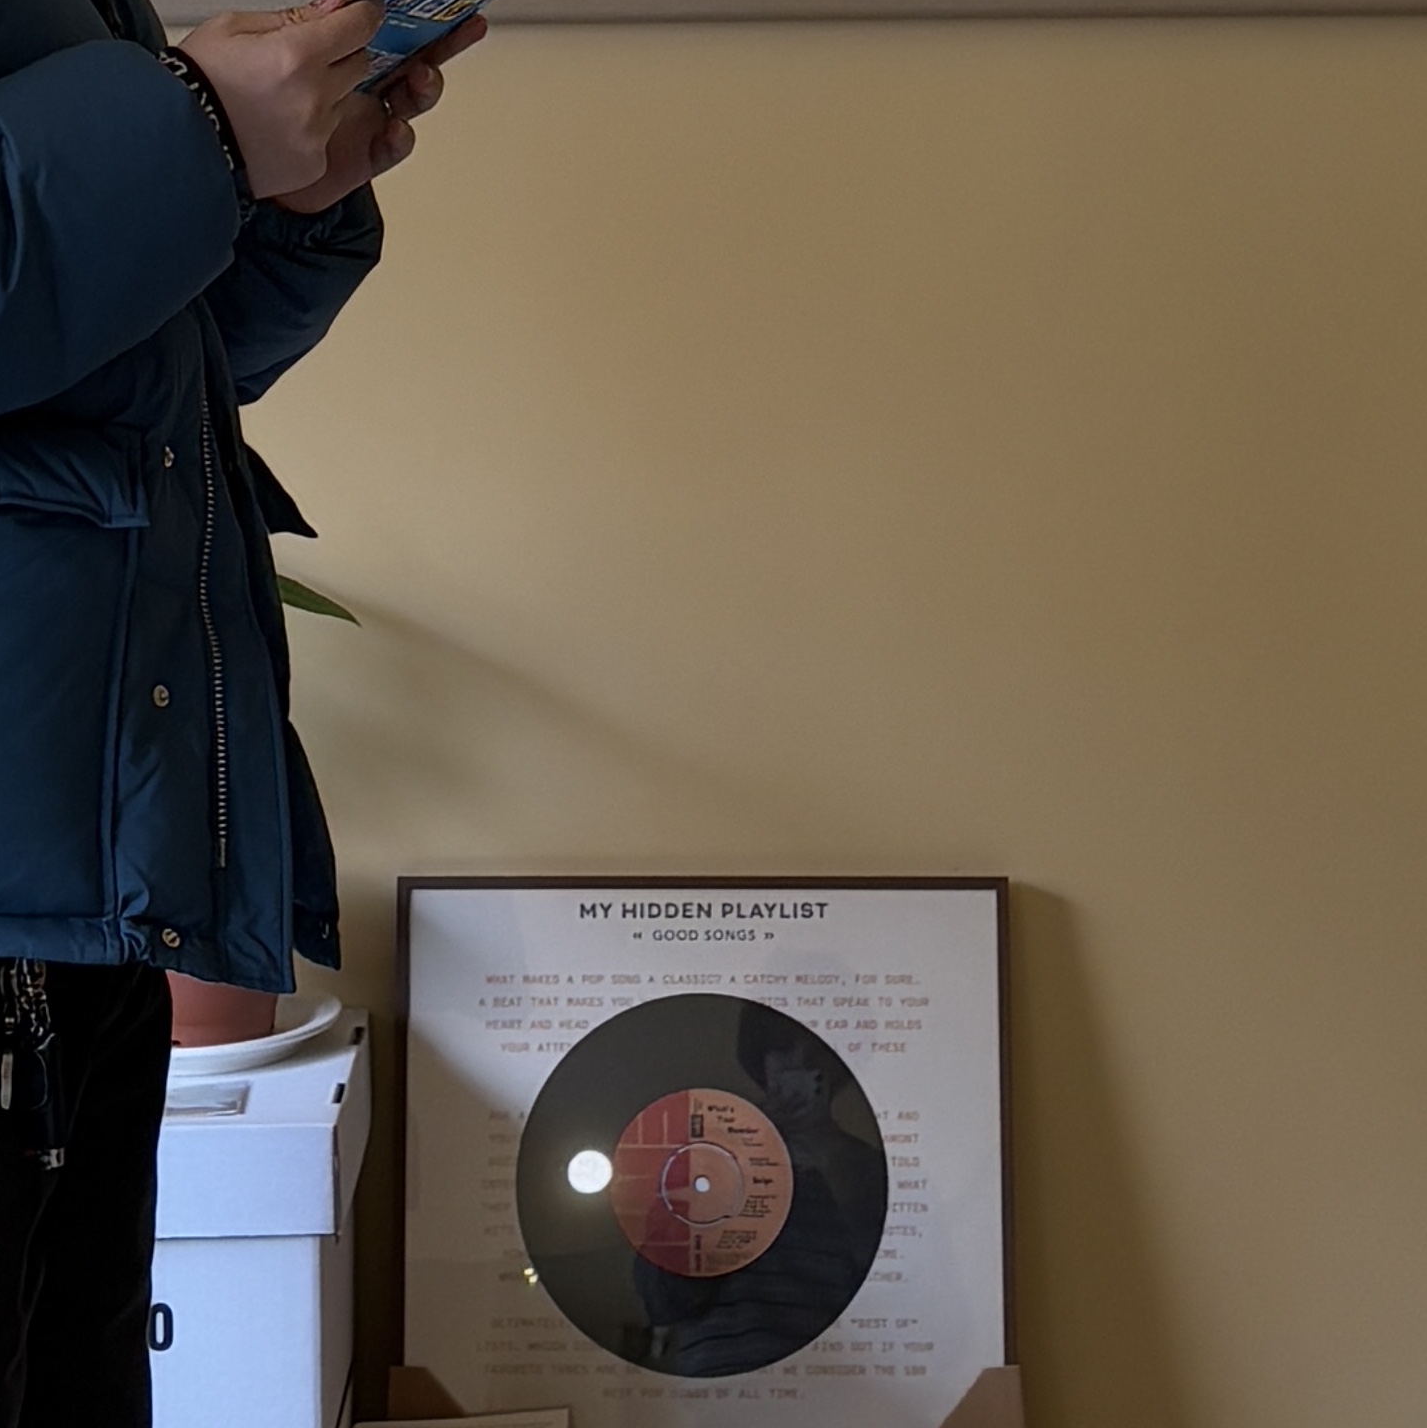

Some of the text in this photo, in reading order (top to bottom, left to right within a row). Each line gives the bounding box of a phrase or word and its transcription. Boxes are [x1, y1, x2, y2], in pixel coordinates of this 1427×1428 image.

[580, 903, 828, 919] MY HIDDEN PLAYLIST
[652, 930, 755, 941] GOOD SONGS
